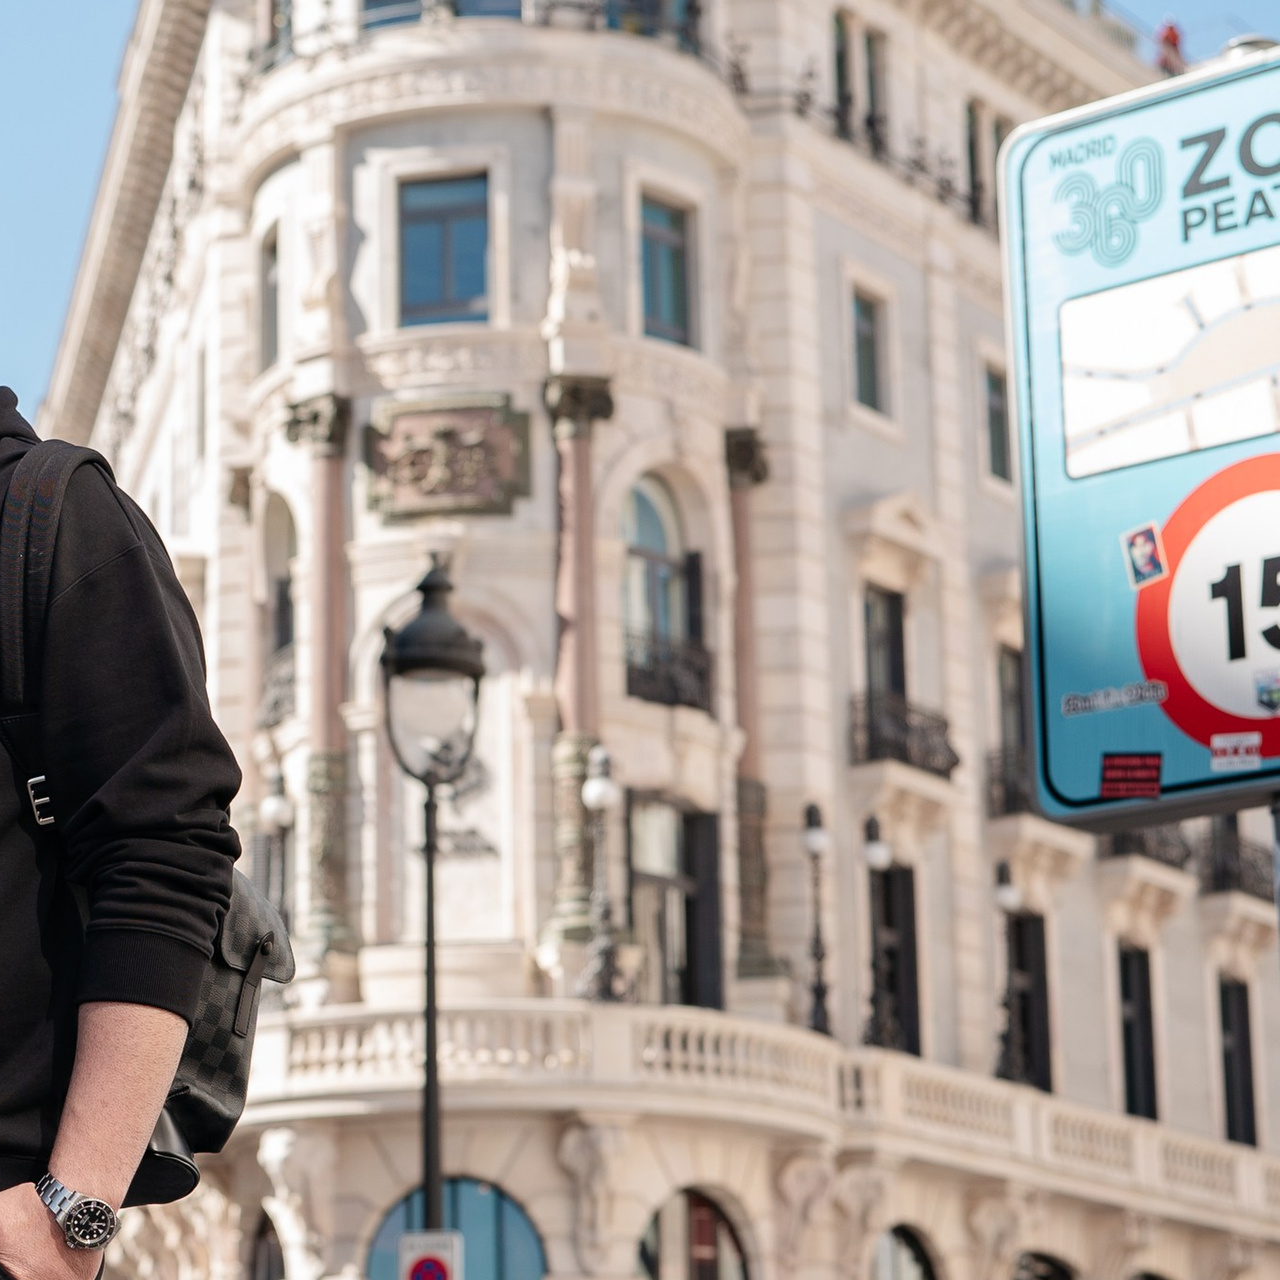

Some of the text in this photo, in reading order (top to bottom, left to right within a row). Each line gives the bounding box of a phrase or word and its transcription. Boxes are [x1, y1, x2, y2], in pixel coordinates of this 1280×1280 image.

[1049, 134, 1116, 169] MADRID
[1181, 113, 1280, 198] ZO
[1182, 186, 1280, 242] PEA
